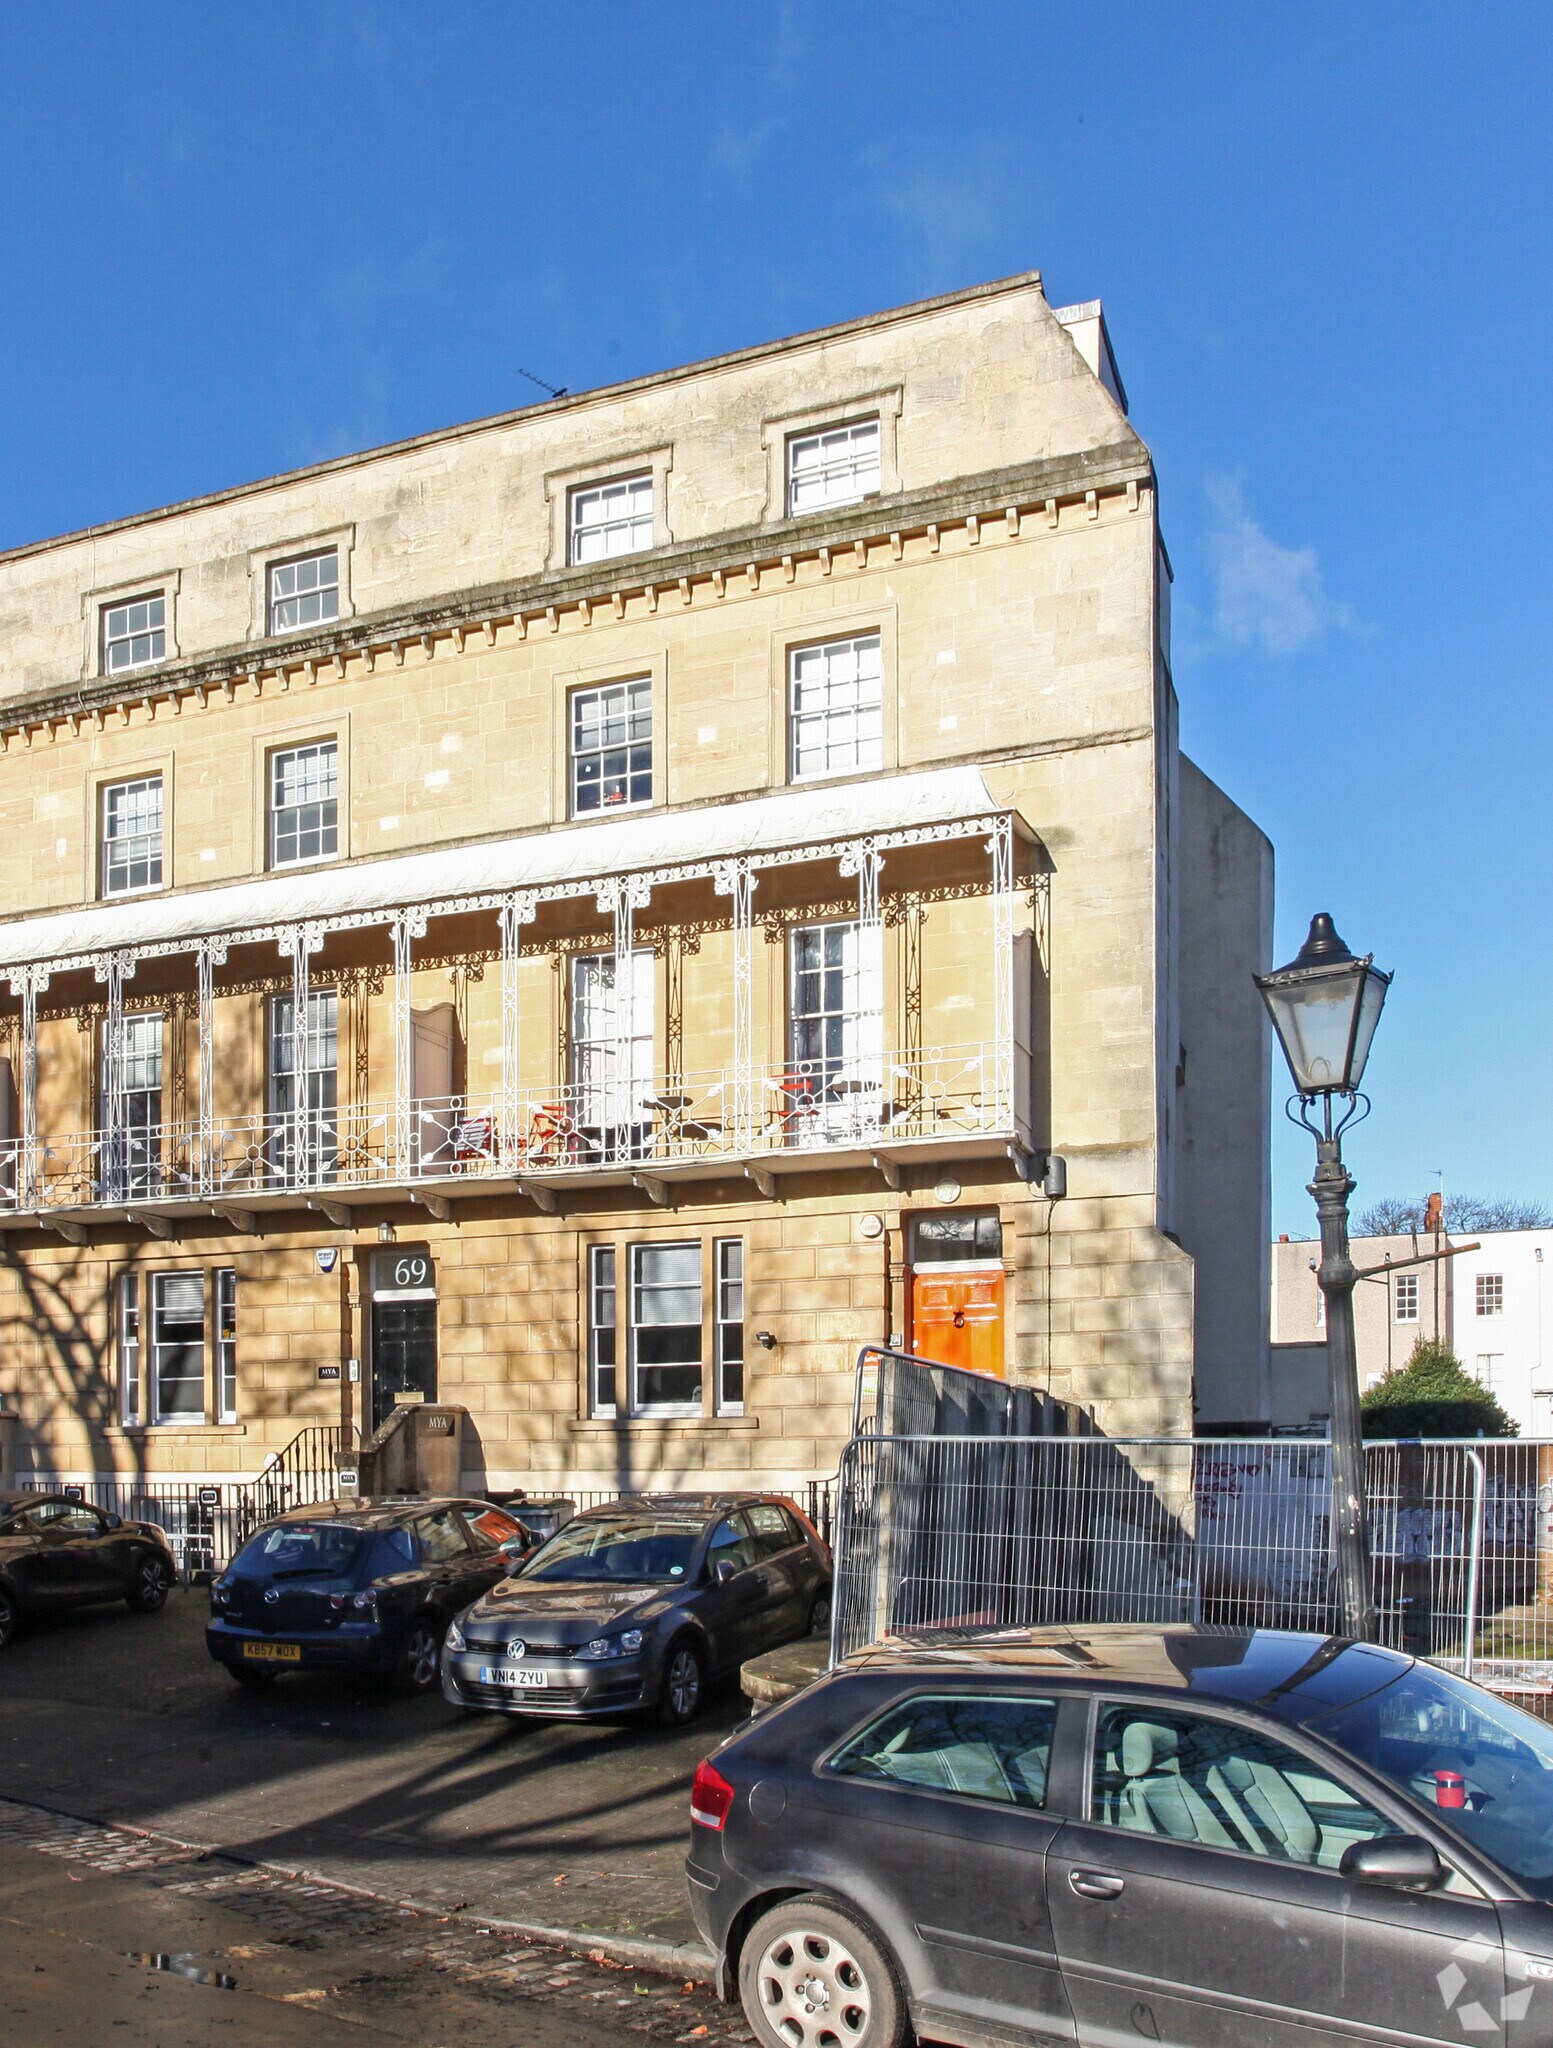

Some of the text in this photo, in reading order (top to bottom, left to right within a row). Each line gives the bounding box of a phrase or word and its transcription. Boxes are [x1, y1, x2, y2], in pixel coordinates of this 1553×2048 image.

[394, 1258, 427, 1285] 69
[429, 1416, 447, 1429] MYA
[247, 1643, 273, 1656] KB57
[491, 1670, 543, 1685] VN14 ZYU
